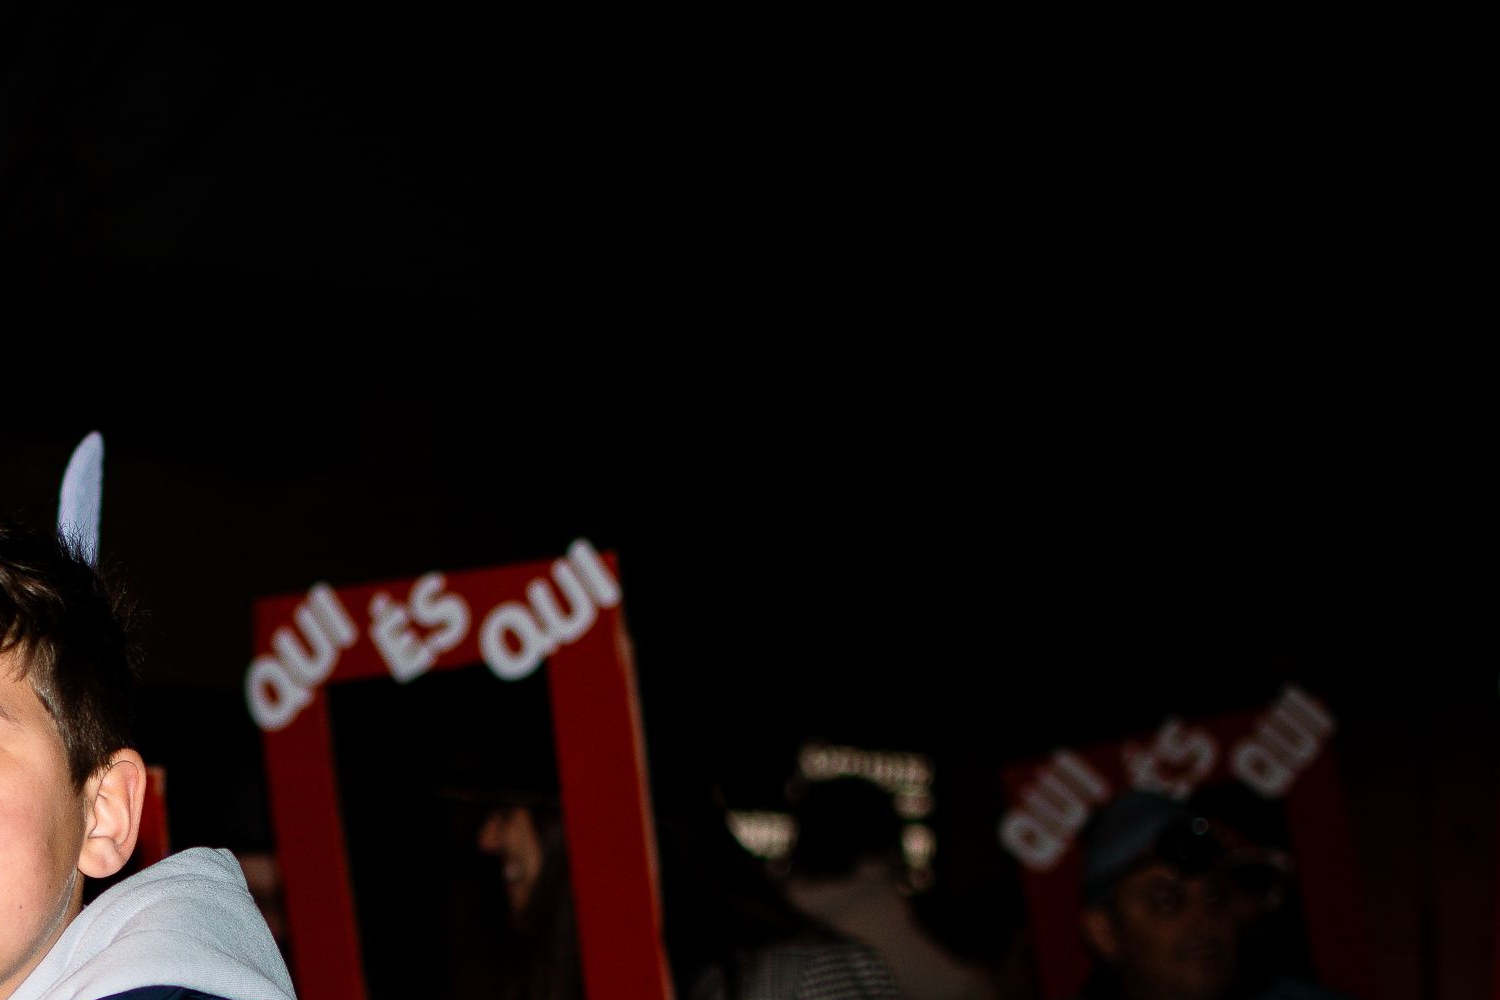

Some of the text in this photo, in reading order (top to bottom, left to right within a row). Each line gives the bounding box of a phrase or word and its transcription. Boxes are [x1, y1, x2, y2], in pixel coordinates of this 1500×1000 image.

[245, 538, 621, 731] QUI ÉS QUI
[996, 744, 1112, 873] QUI
[1227, 678, 1340, 800] QUI
